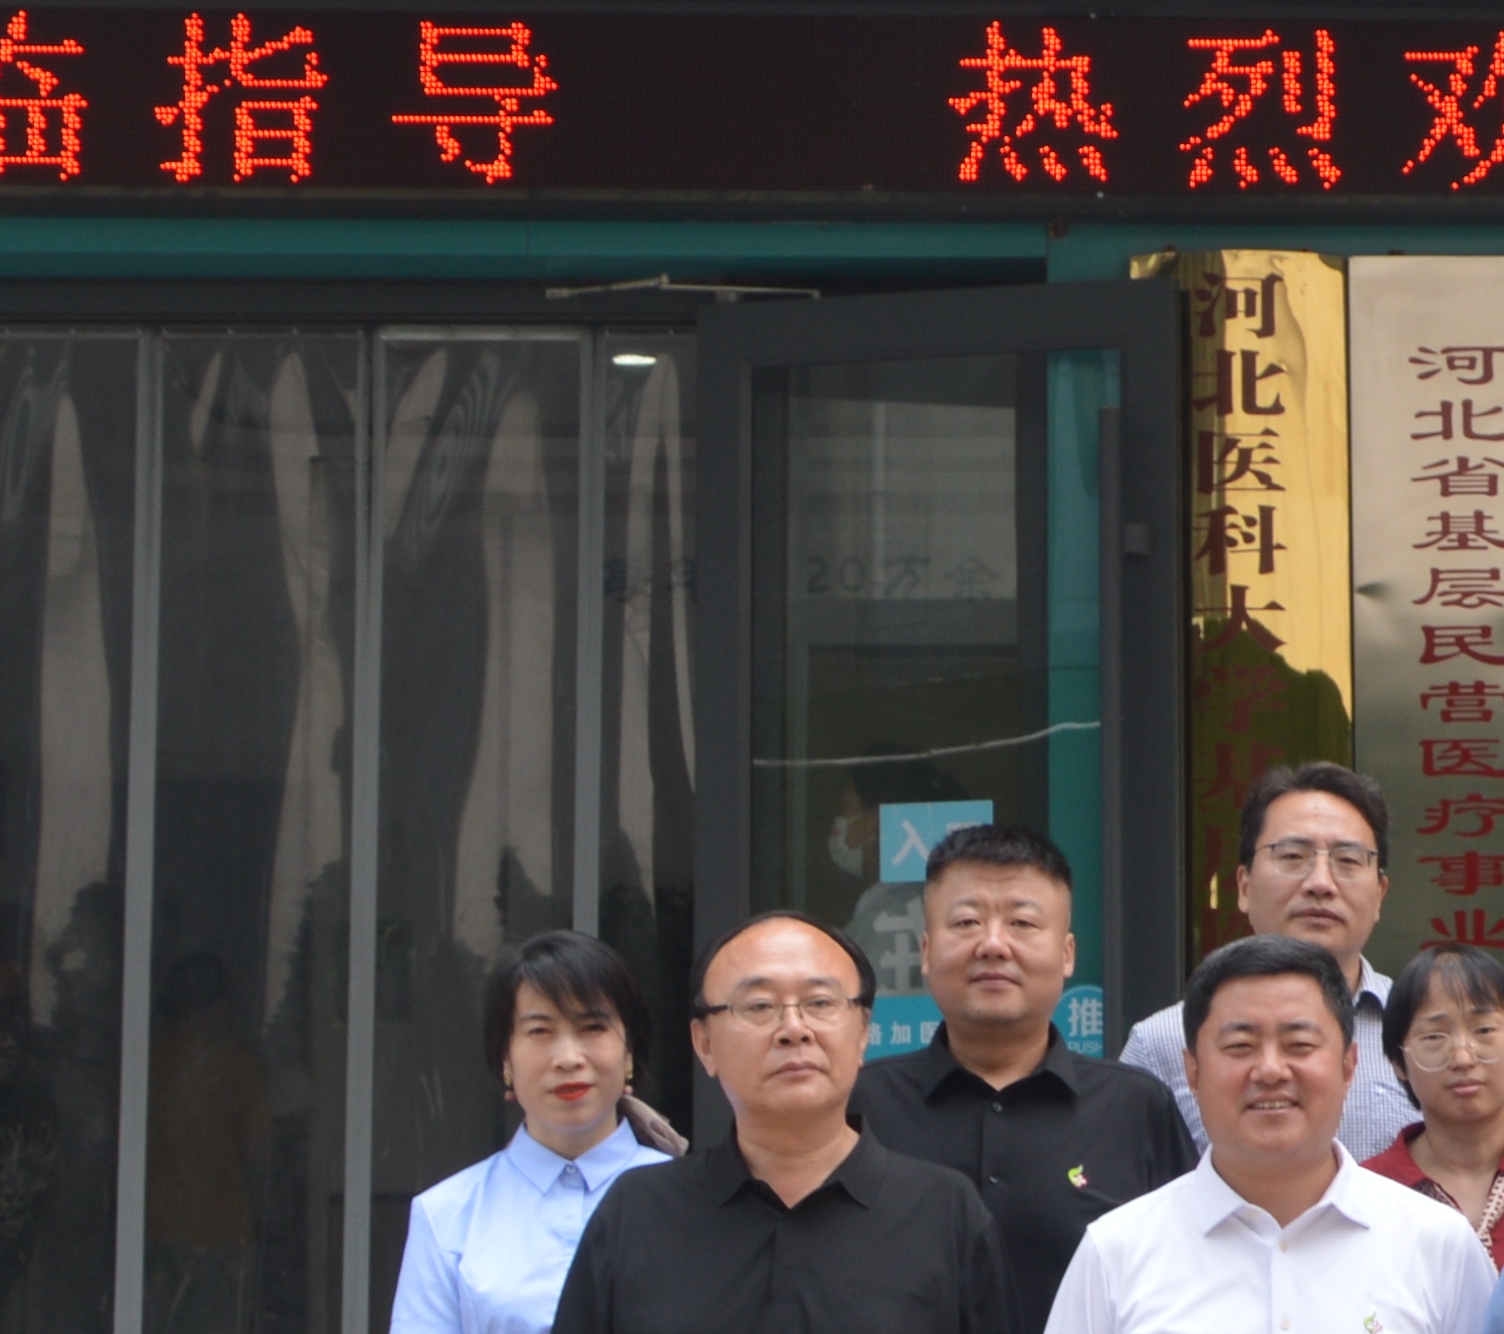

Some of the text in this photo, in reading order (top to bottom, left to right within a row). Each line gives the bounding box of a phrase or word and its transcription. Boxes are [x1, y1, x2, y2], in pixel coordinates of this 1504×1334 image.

[1193, 270, 1289, 963] 河北医科大学基
[1068, 997, 1103, 1037] 推
